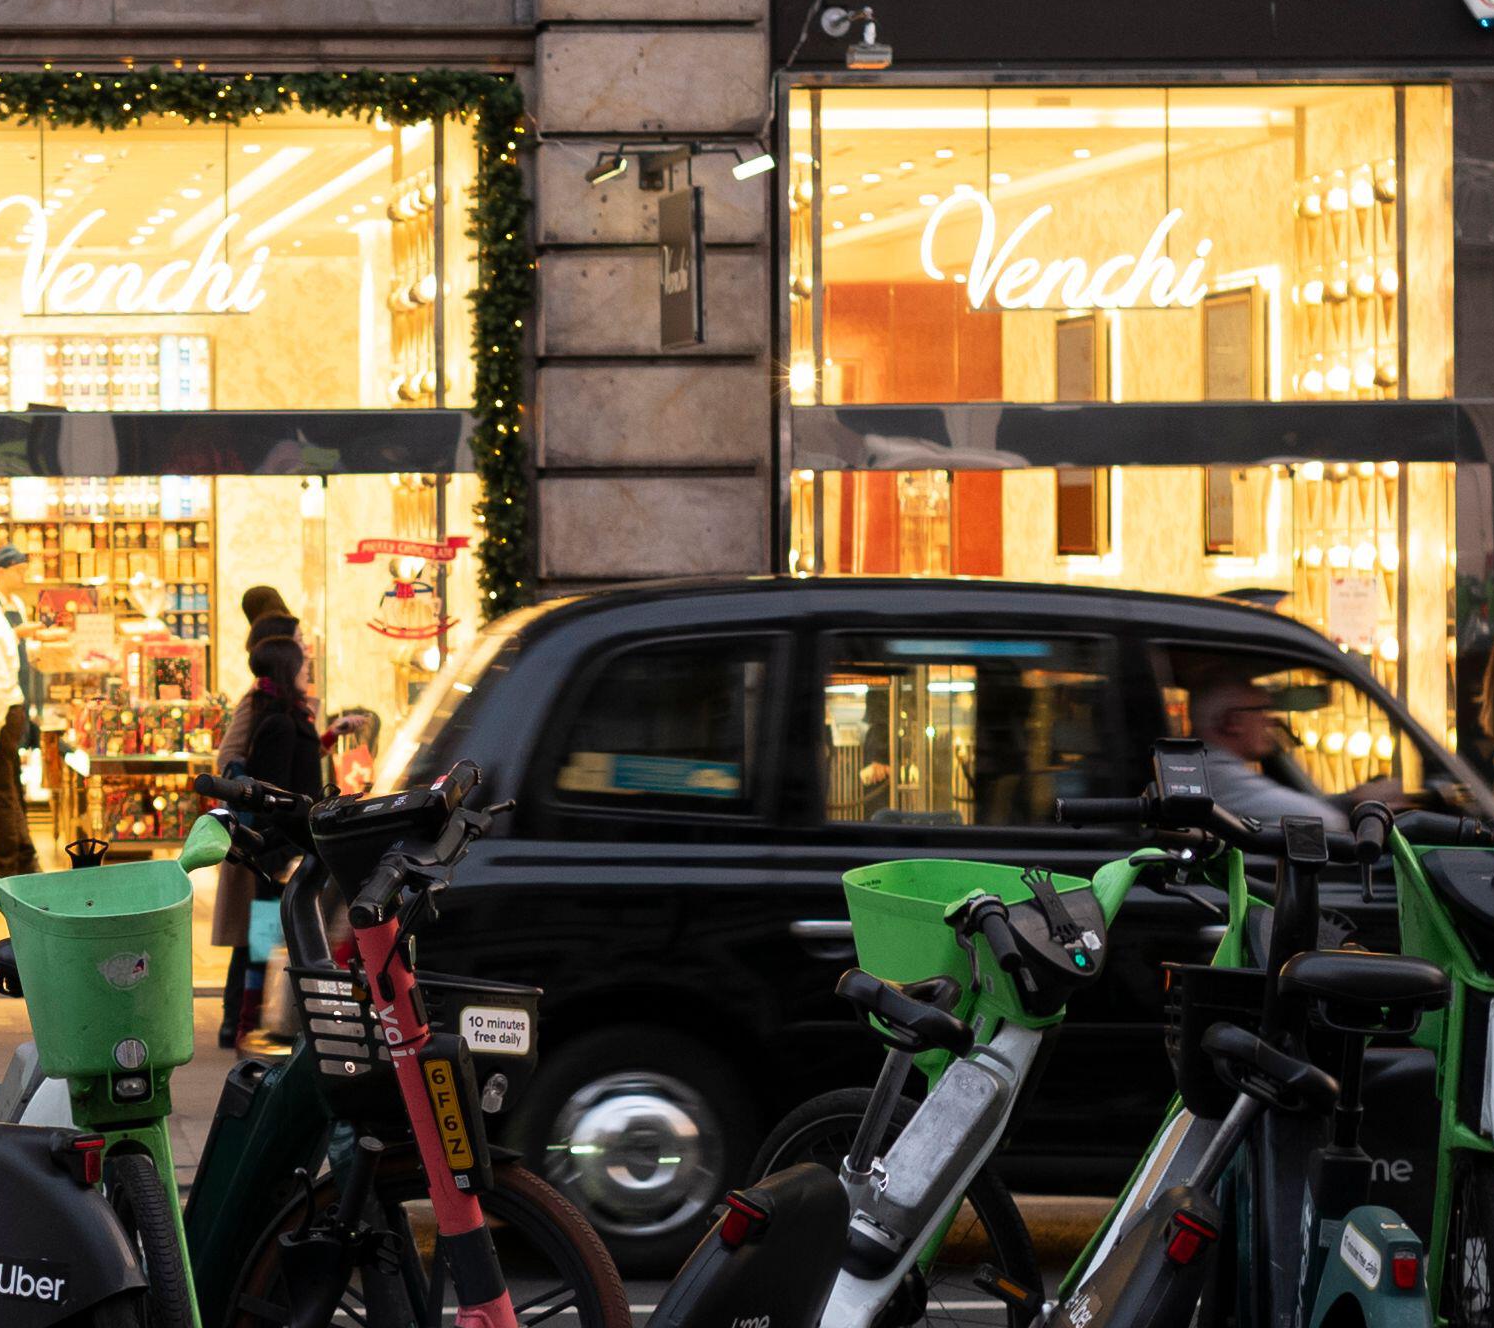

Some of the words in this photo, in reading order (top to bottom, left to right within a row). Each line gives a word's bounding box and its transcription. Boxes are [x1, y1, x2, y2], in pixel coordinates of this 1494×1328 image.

[920, 189, 1212, 310] Venchi
[468, 1016, 484, 1028] 10
[486, 1016, 526, 1032] minutes
[474, 1030, 497, 1044] free
[499, 1032, 522, 1047] daily
